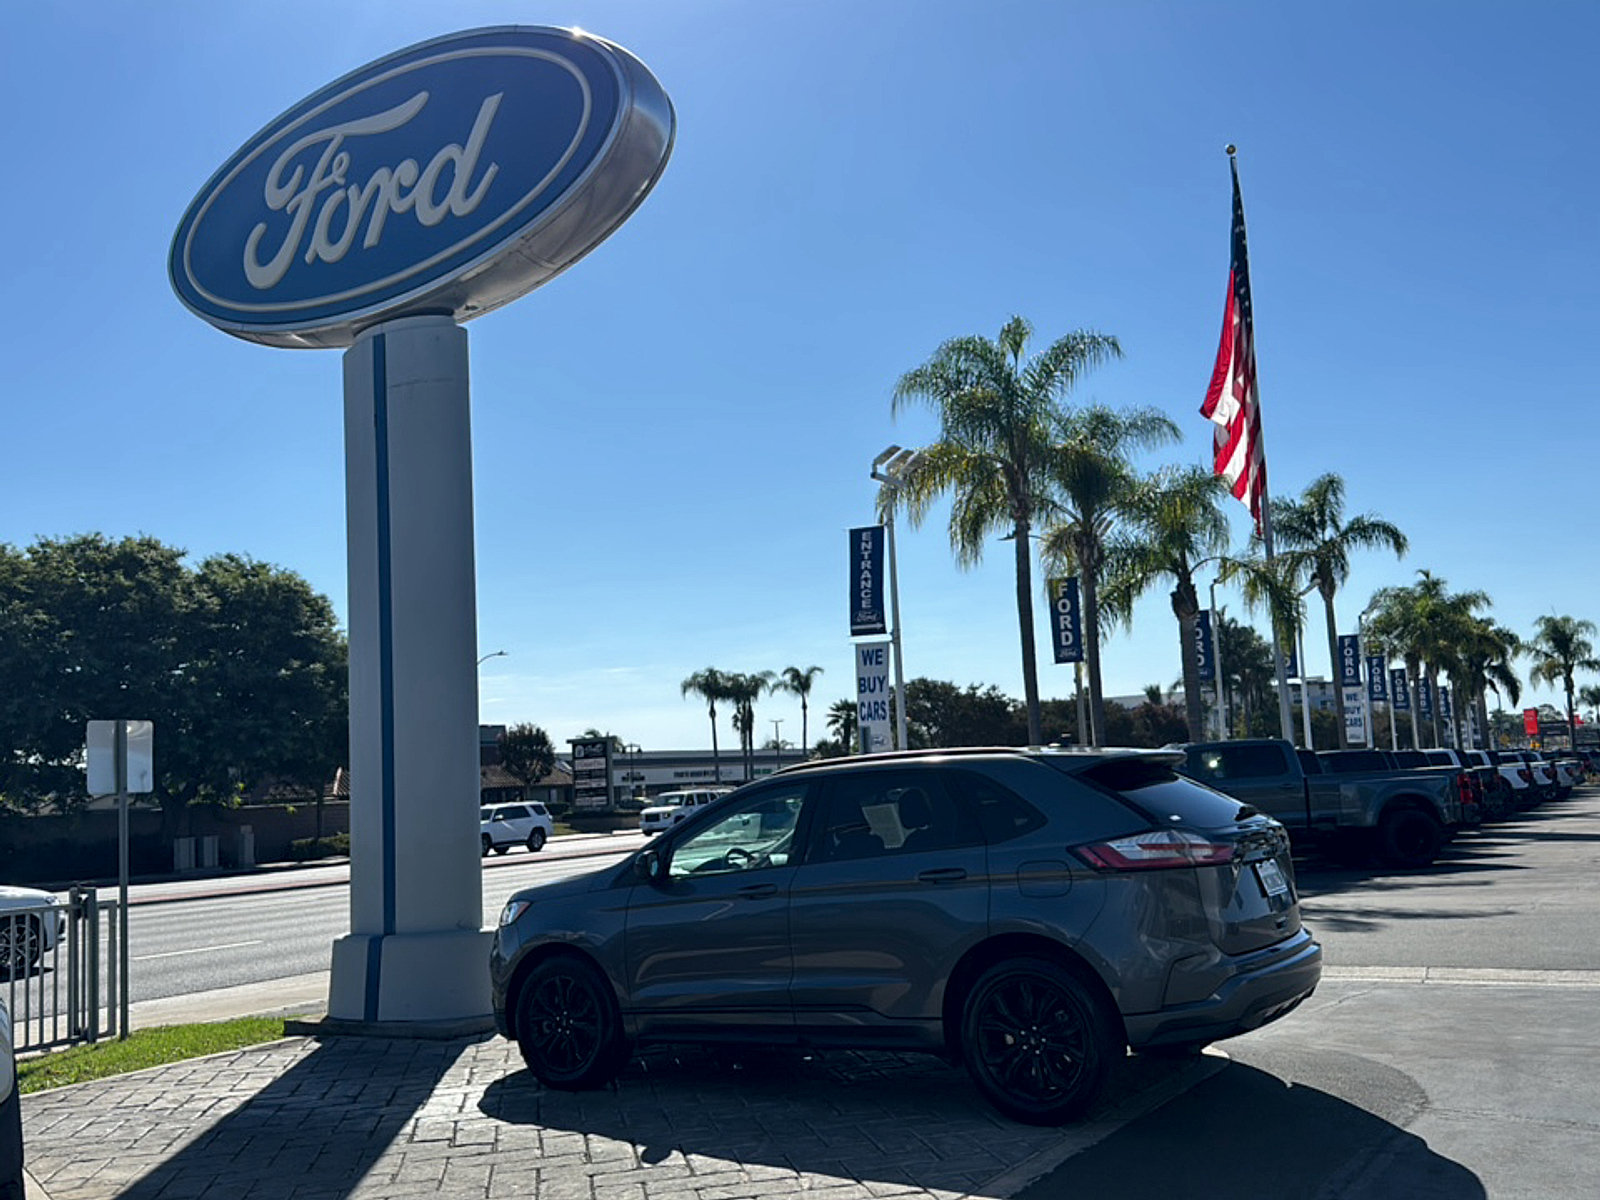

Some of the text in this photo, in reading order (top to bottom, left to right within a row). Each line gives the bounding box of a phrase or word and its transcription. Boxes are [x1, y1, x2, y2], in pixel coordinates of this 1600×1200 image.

[243, 91, 504, 290] Ford
[860, 531, 872, 608] ENTRANCE
[1057, 581, 1074, 646] FORD
[861, 648, 883, 666] WE
[1343, 637, 1355, 676] FORD
[859, 675, 886, 694] BUY
[1371, 658, 1382, 692] FORD
[1395, 671, 1405, 701] FORD
[860, 701, 887, 721] CARS
